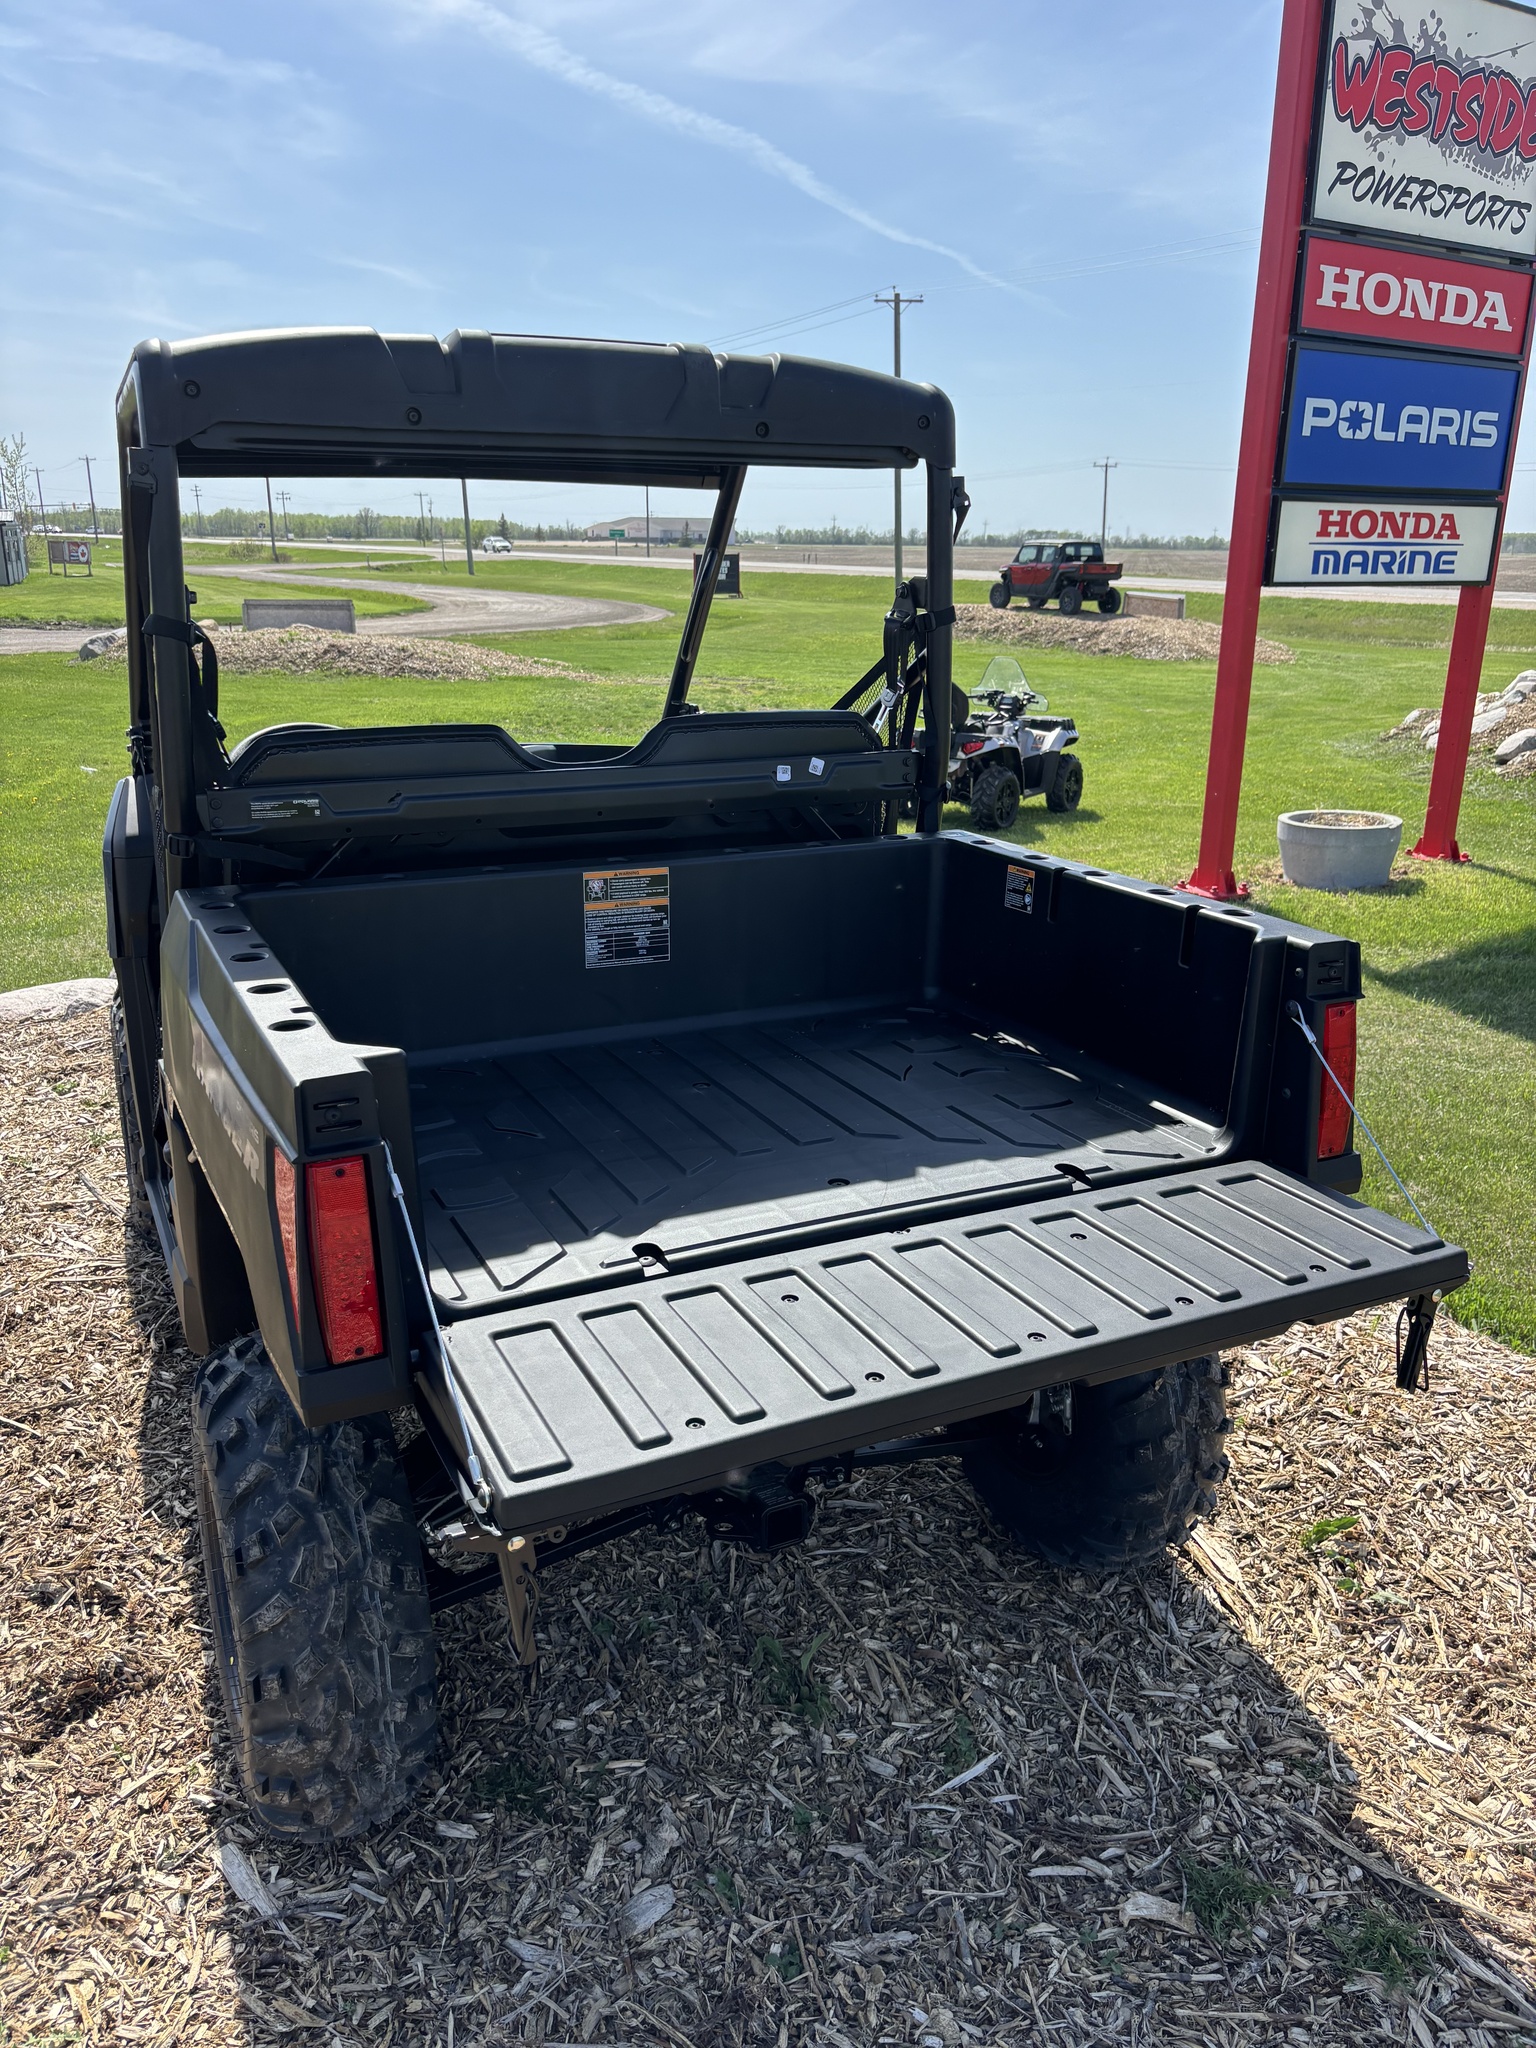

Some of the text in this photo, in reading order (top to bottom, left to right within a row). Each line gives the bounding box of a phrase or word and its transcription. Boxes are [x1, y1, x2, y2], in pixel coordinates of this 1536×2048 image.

[1328, 161, 1532, 235] POWERSPORTS
[1316, 264, 1512, 332] HONDA
[1302, 397, 1499, 447] POLARIS
[1316, 509, 1460, 540] HONDA
[1311, 550, 1458, 575] MARINE
